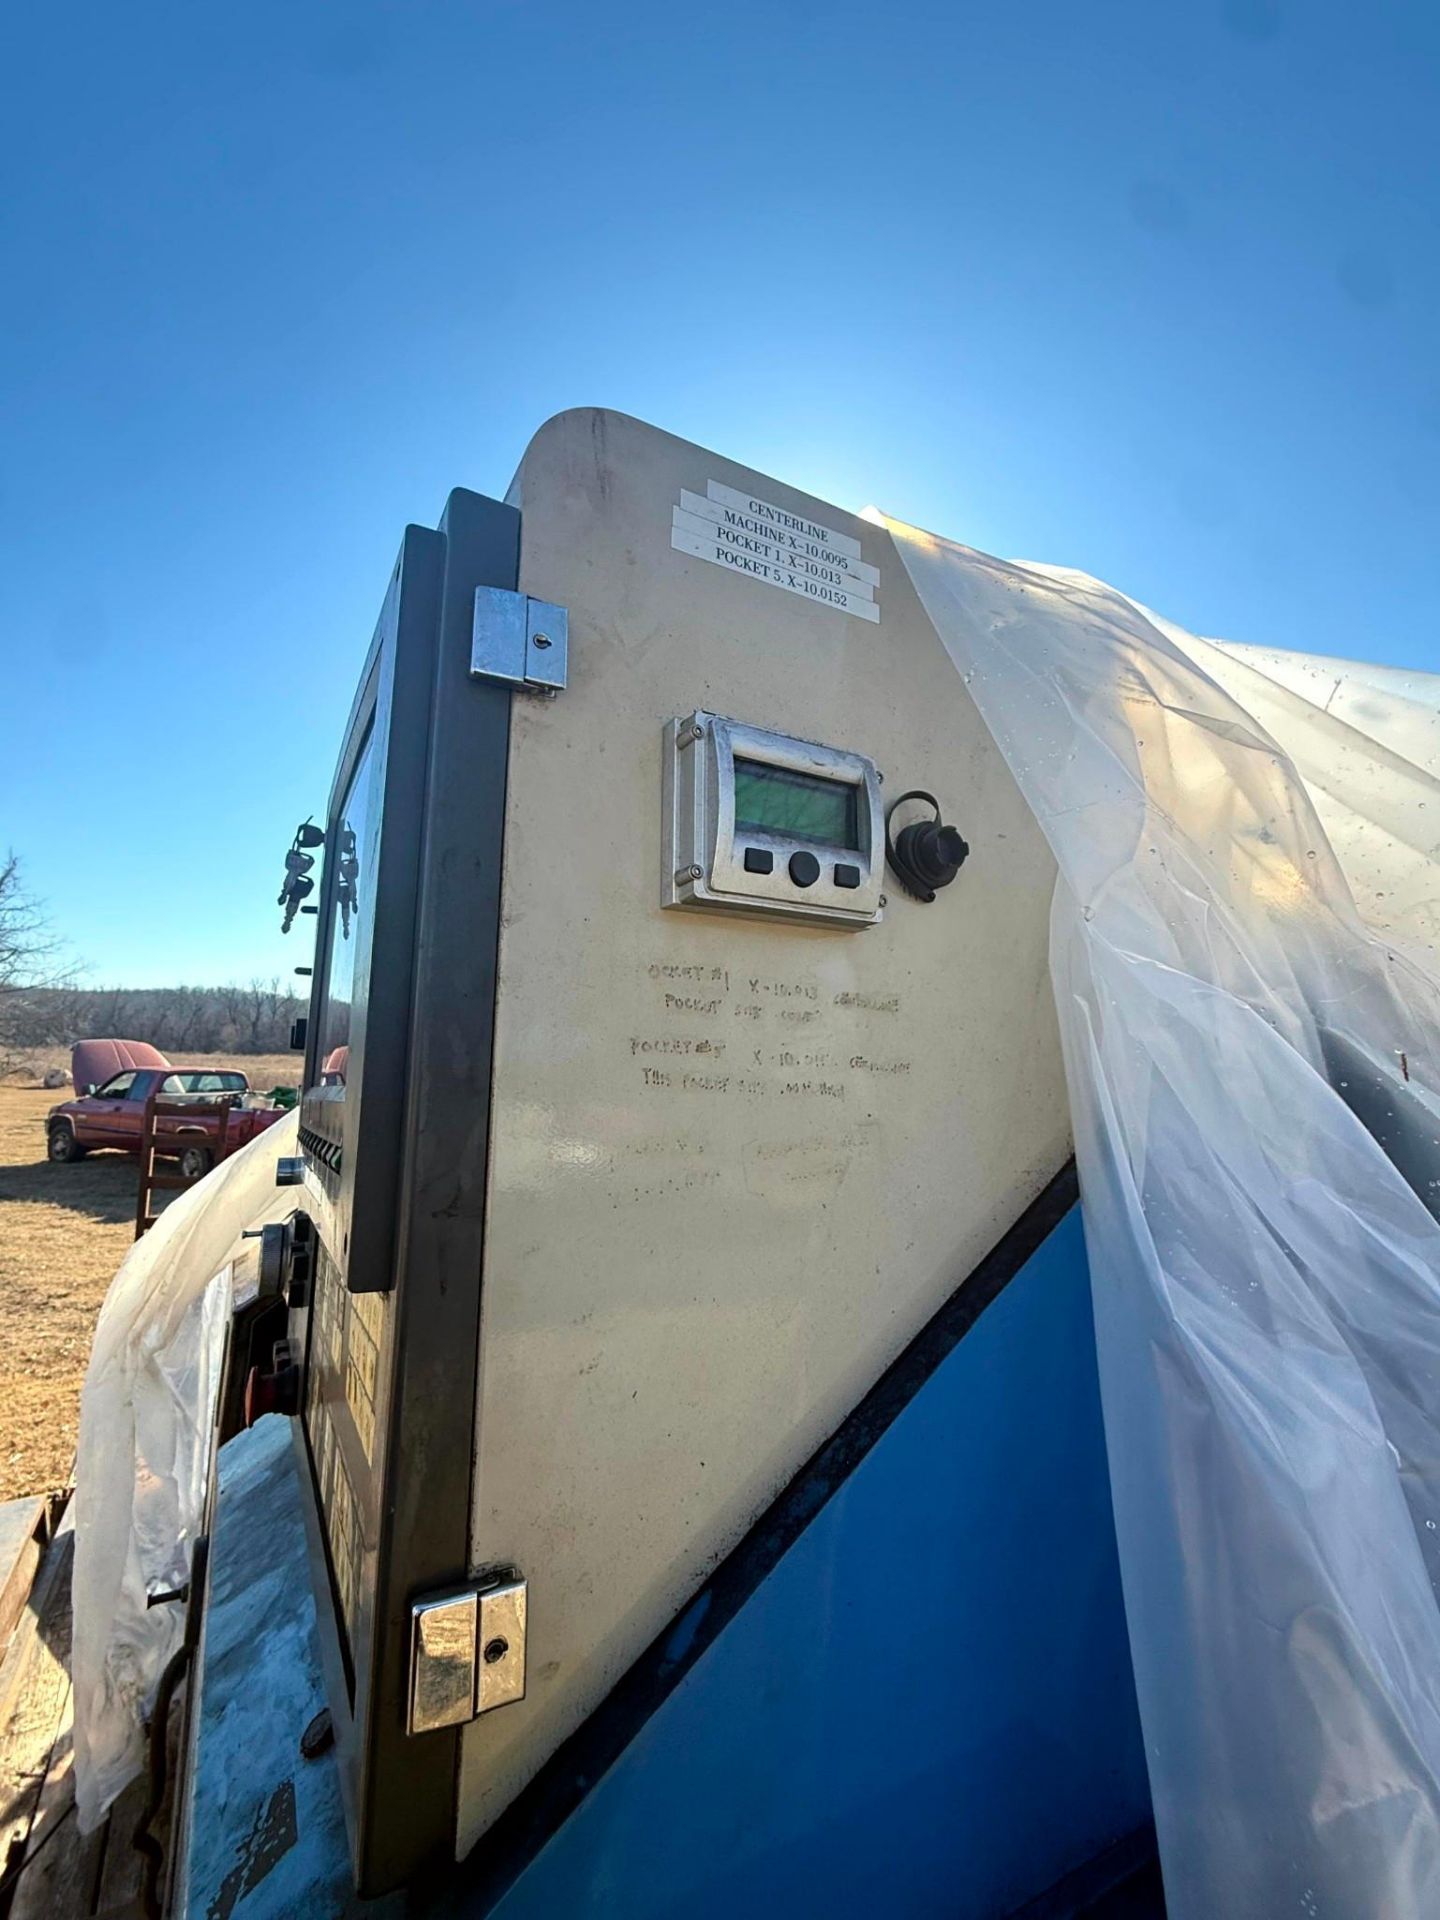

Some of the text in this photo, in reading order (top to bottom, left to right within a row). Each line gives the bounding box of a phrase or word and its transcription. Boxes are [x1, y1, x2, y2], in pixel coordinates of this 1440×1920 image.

[724, 509, 849, 570] MACHINE X-10.0095
[749, 500, 829, 542] CENTERLINE
[716, 527, 841, 585] POCKET 1. X-10.013
[716, 547, 848, 607] POCKET 5. X-10.0152
[646, 963, 704, 981] OCKET
